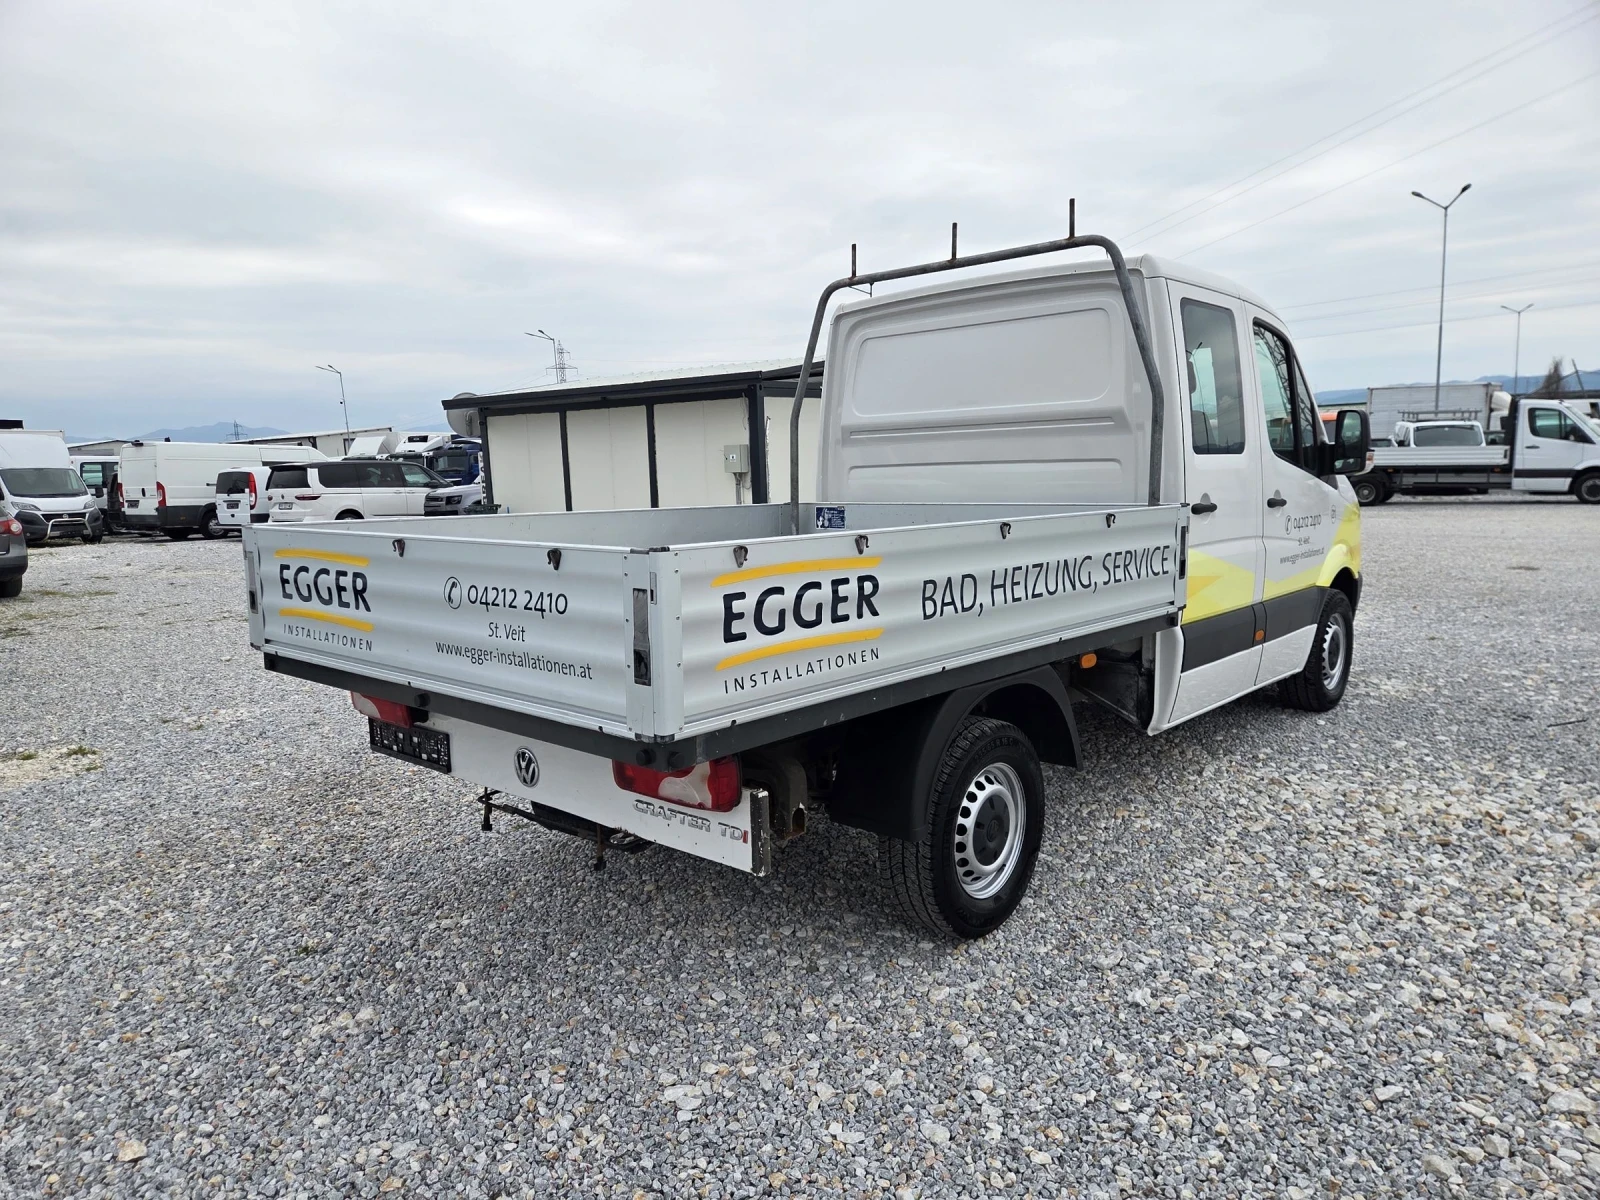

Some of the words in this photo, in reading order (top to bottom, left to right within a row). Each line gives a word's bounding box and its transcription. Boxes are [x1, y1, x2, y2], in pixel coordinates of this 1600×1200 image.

[279, 563, 372, 613] EGGER
[467, 584, 518, 613] 04212
[523, 589, 569, 620] 2410
[921, 573, 984, 621] BAD,
[990, 555, 1098, 607] HEIZUNG,
[1102, 544, 1171, 586] SERVICE
[722, 574, 880, 644] EGGER
[283, 623, 373, 652] INSTALLATIONEN
[488, 621, 502, 639] St.
[503, 623, 526, 643] Veit
[435, 641, 593, 680] www.egger-installationen.at
[724, 647, 880, 695] INSTALLATIONEN
[632, 799, 711, 832] CRAFTER
[717, 822, 749, 844] TDI
